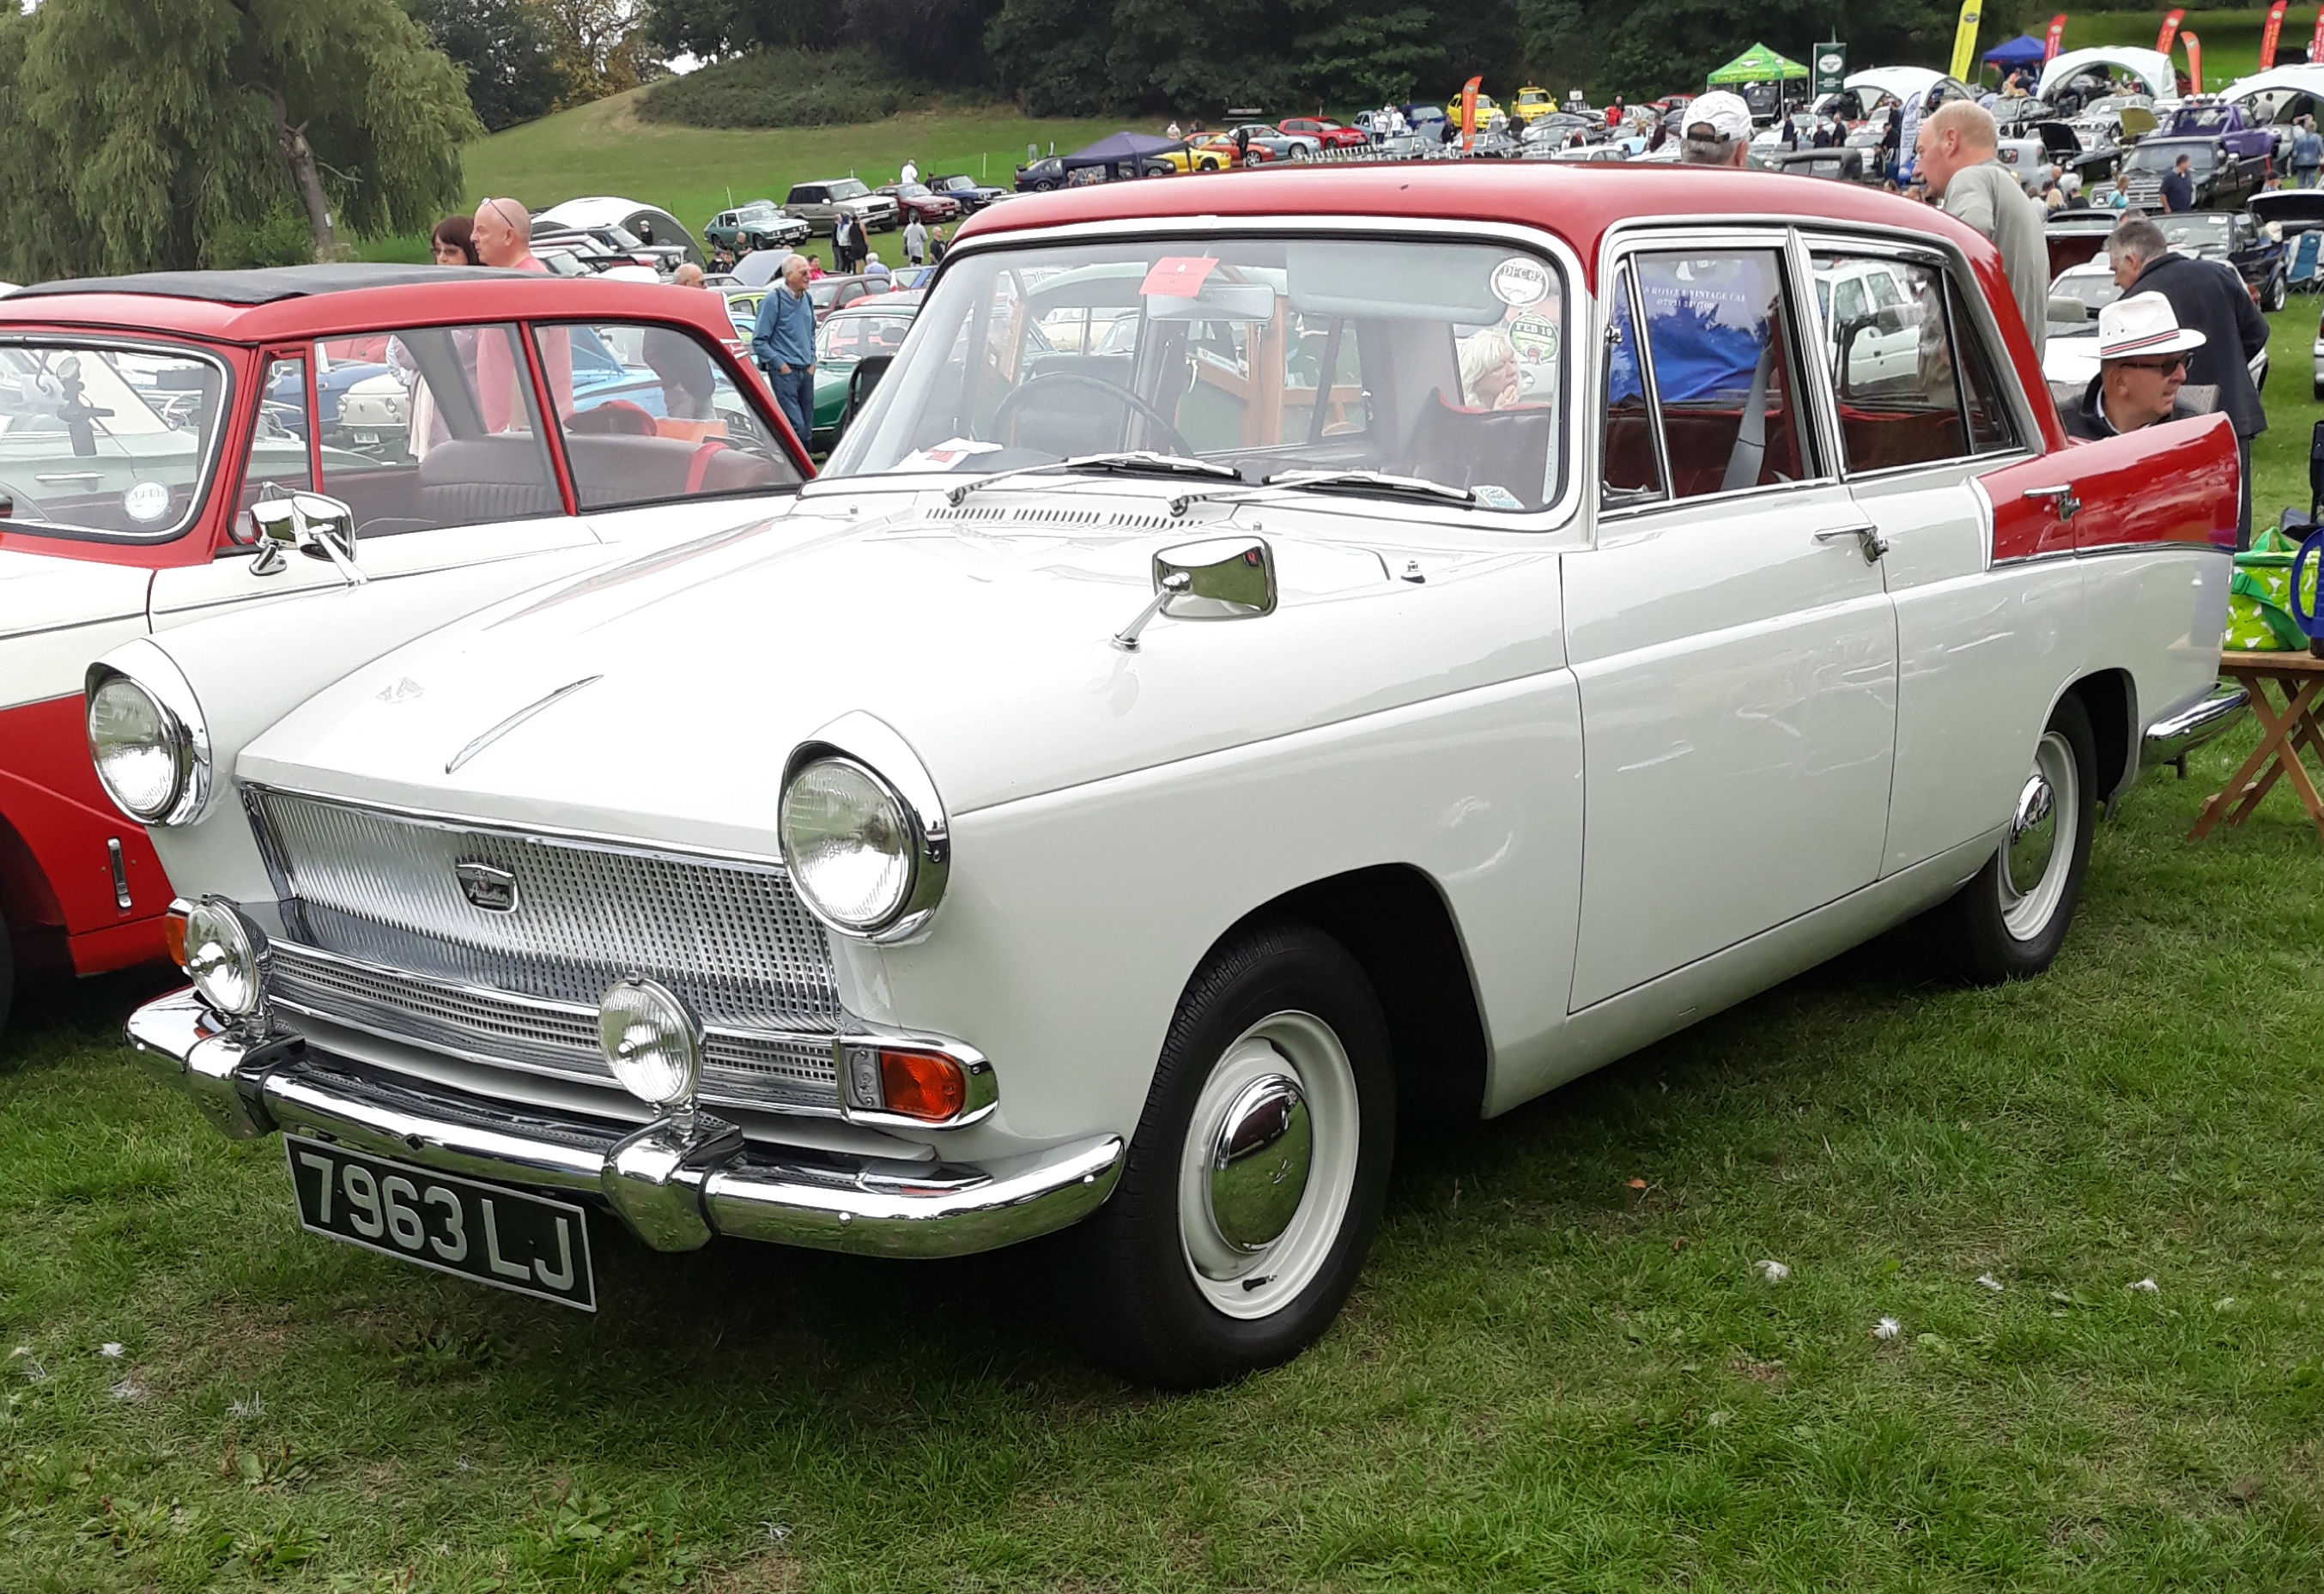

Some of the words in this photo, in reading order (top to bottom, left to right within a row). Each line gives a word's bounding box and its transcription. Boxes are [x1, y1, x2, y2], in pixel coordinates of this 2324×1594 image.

[1514, 322, 1538, 334] FEB
[299, 1150, 469, 1263] 7963
[481, 1197, 575, 1291] LJ
